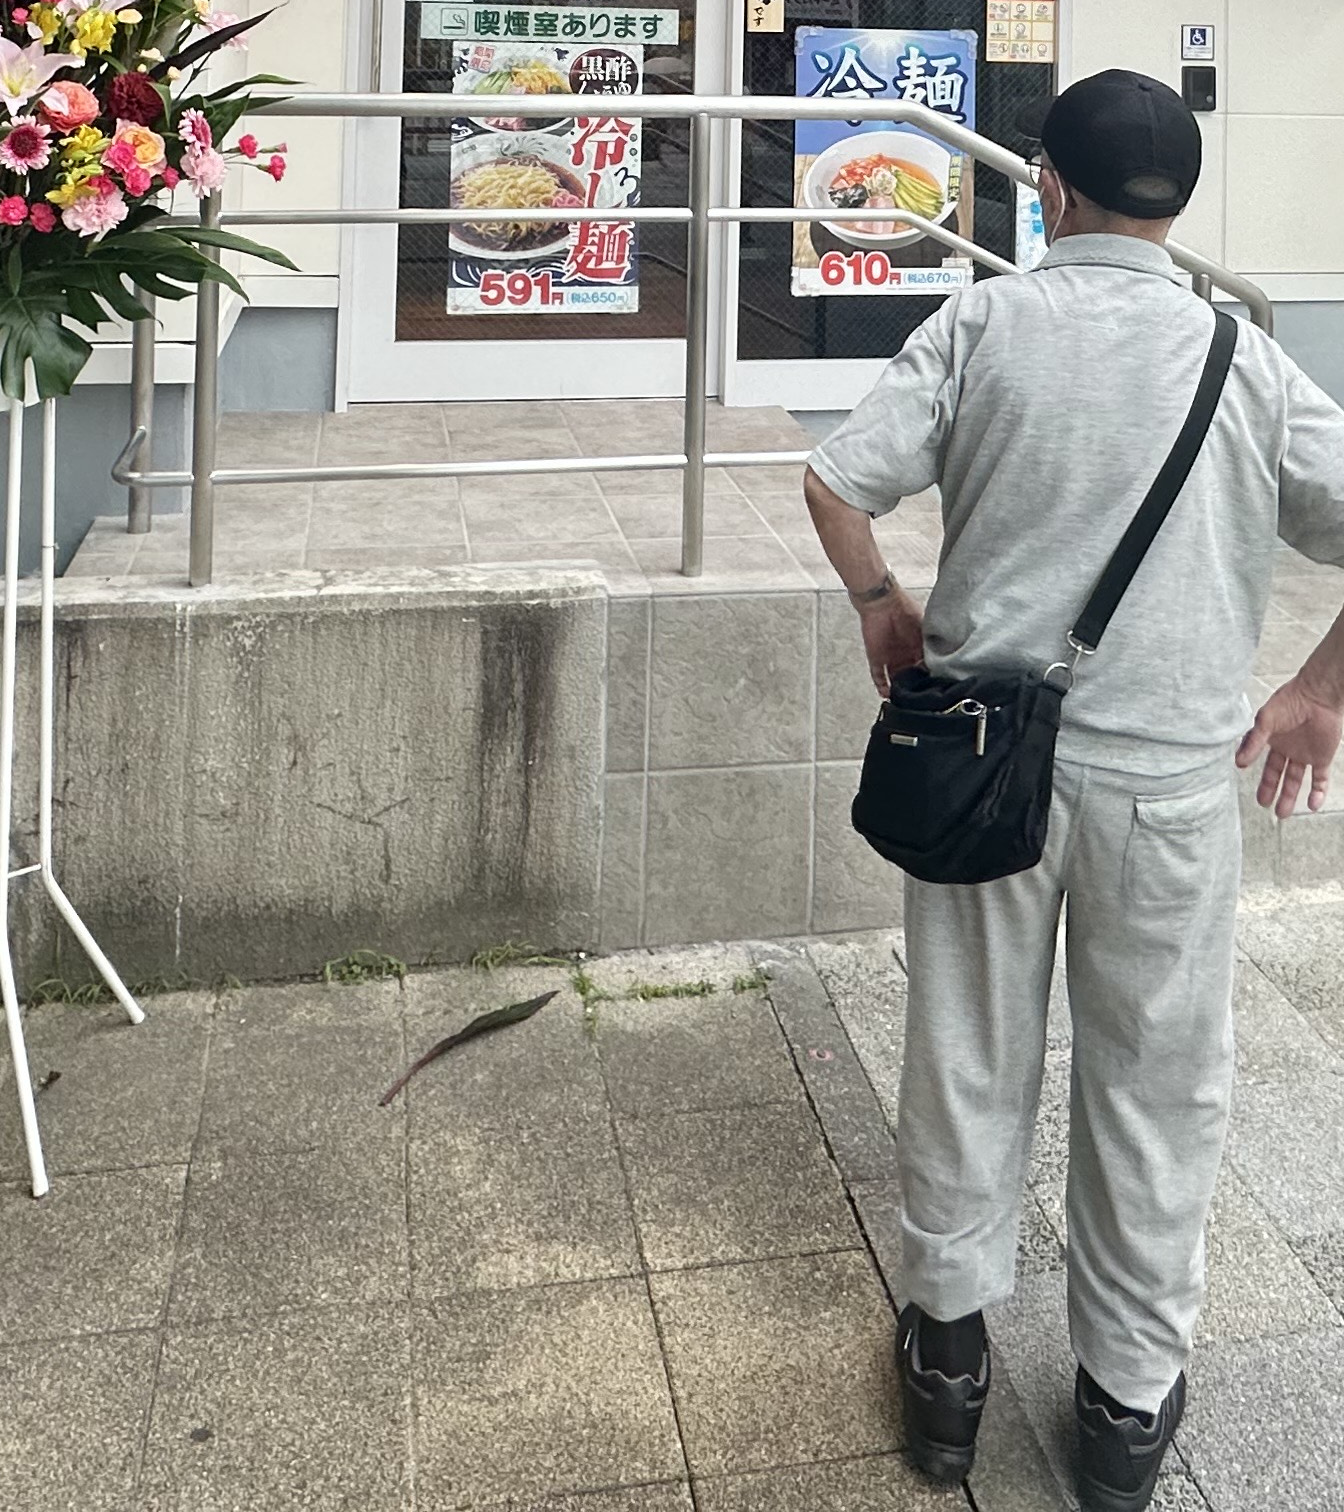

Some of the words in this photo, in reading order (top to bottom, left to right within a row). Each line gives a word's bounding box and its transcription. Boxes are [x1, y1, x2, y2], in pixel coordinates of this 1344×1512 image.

[474, 10, 663, 39] 喫煙室あります
[579, 55, 632, 81] 黒酢
[821, 253, 901, 285] 610円
[480, 273, 563, 306] 591円
